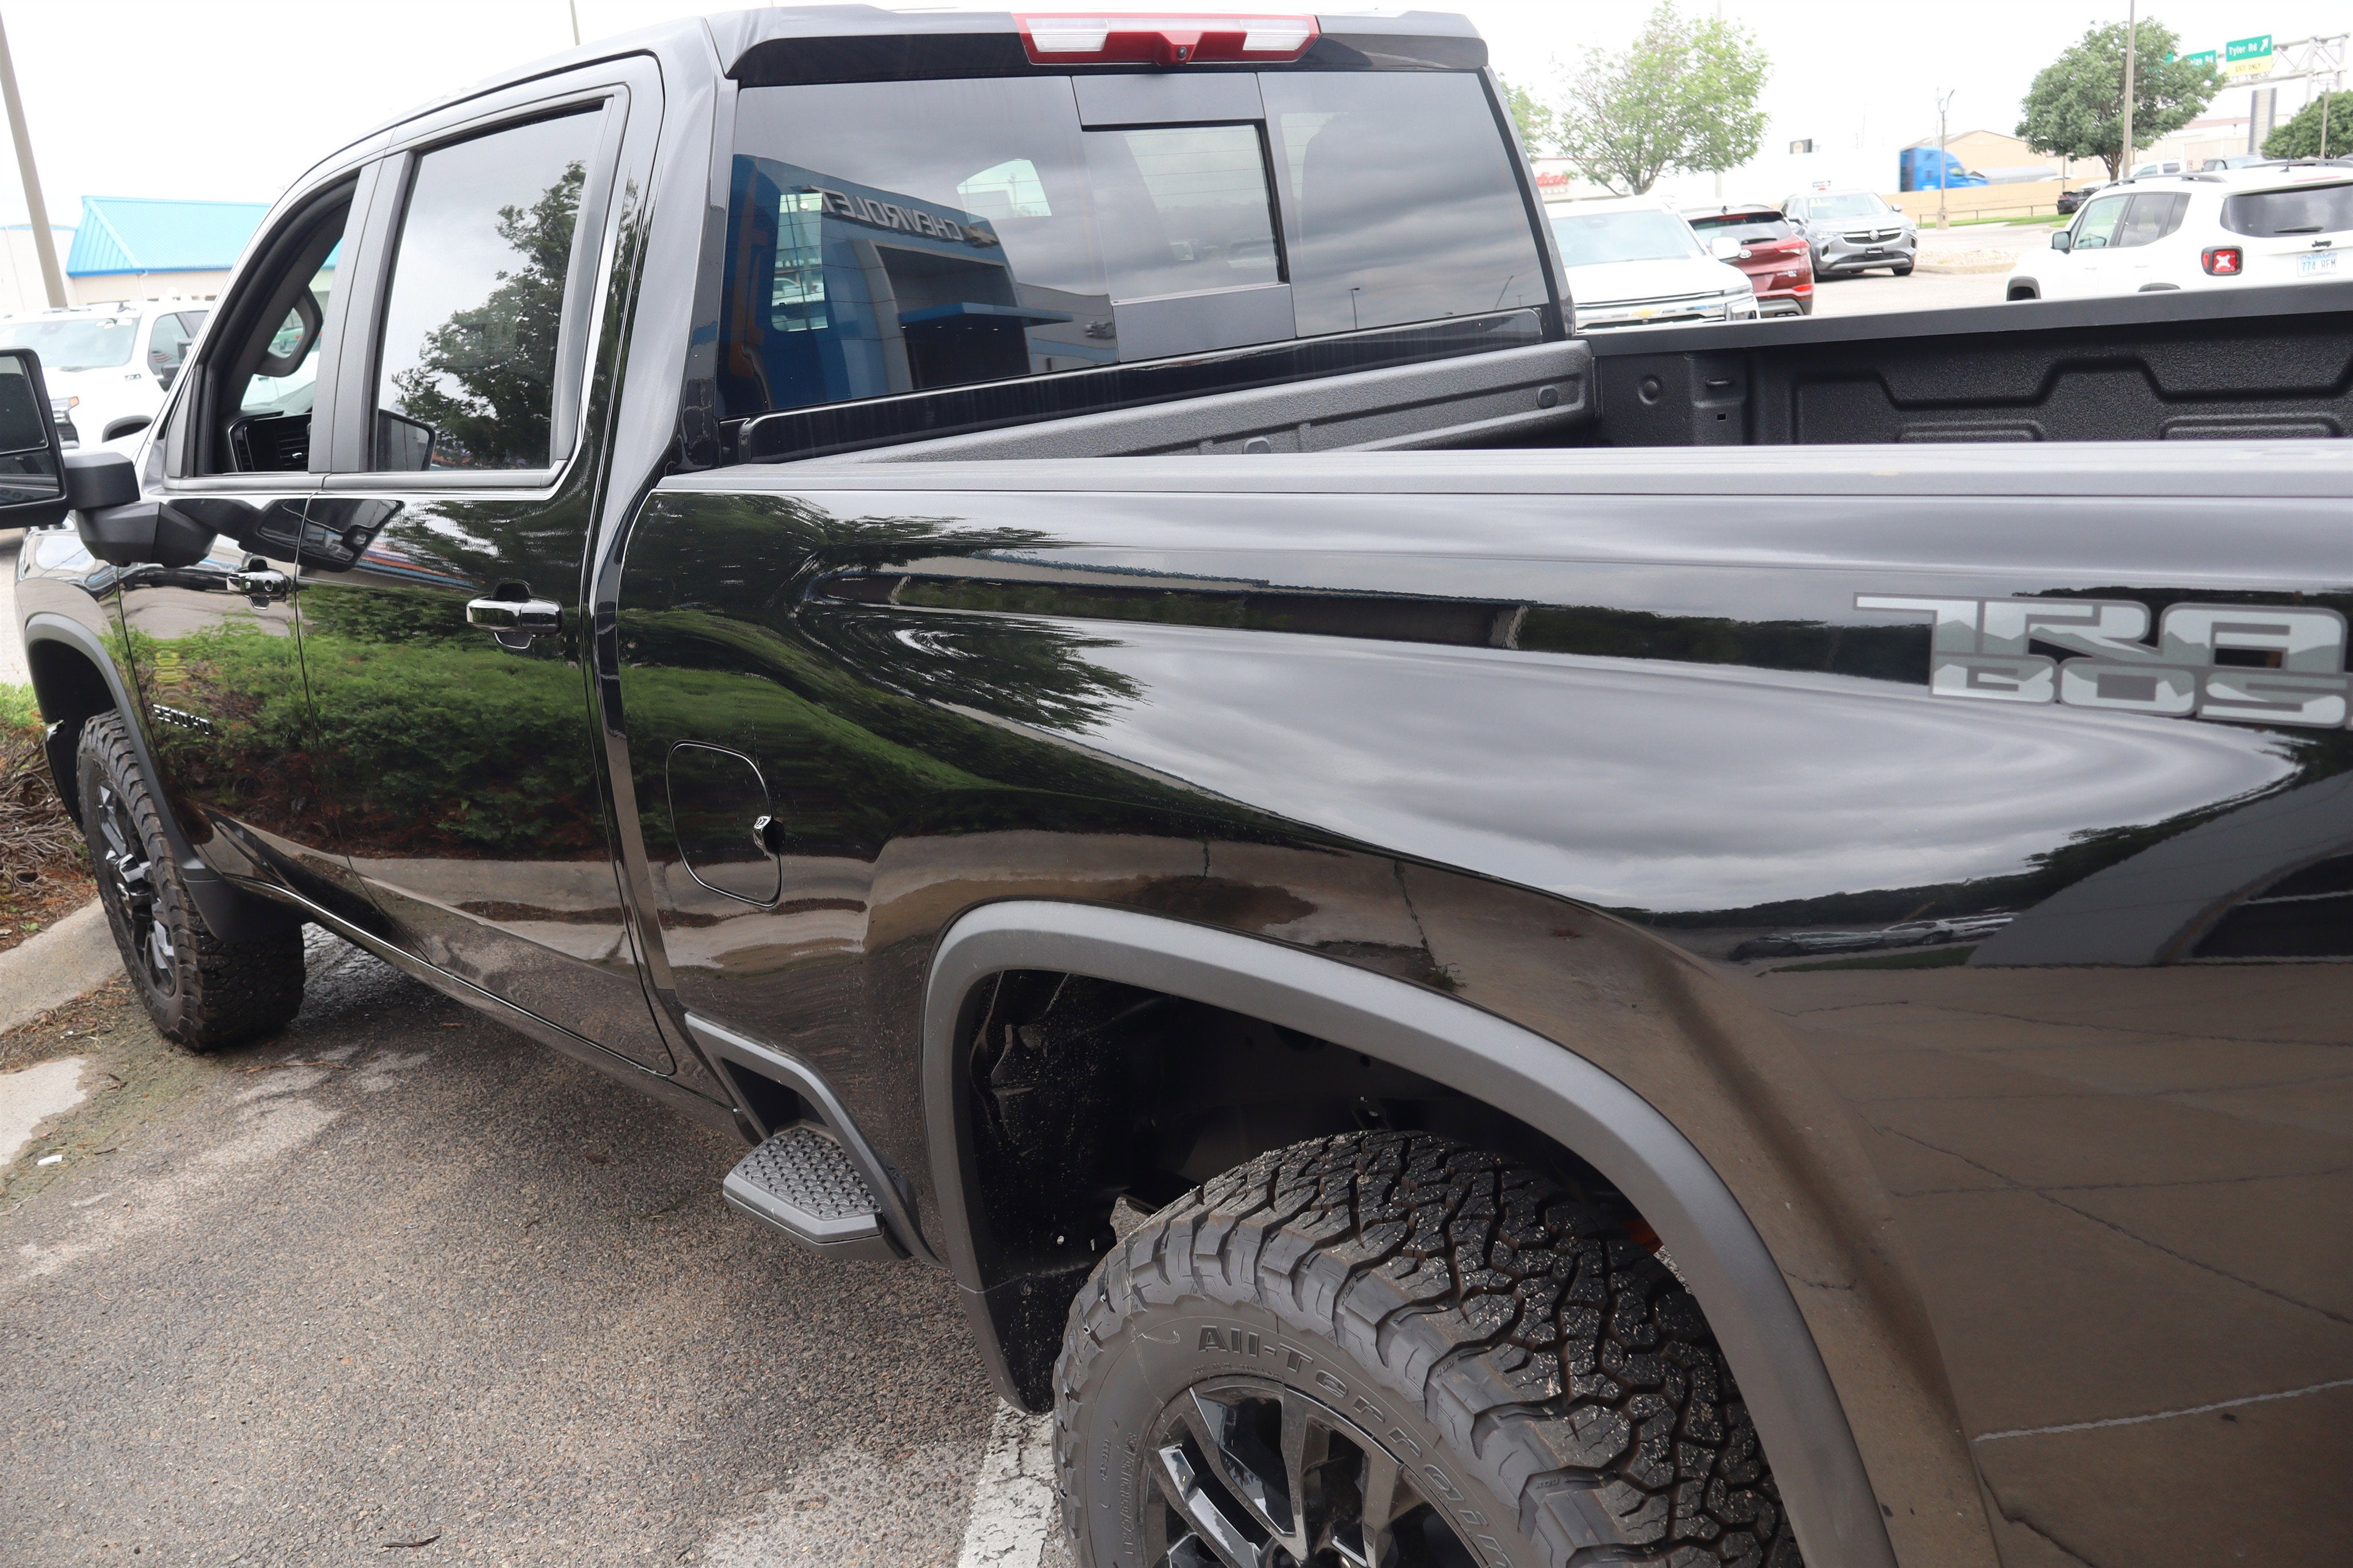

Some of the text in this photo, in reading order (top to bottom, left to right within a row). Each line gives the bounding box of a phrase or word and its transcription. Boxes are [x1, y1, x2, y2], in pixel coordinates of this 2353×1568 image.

[2228, 43, 2258, 57] Tyler Rd
[2248, 62, 2262, 71] ONLY
[2301, 260, 2316, 272] 774
[1929, 652, 2353, 728] BOS
[152, 704, 192, 729] 2500
